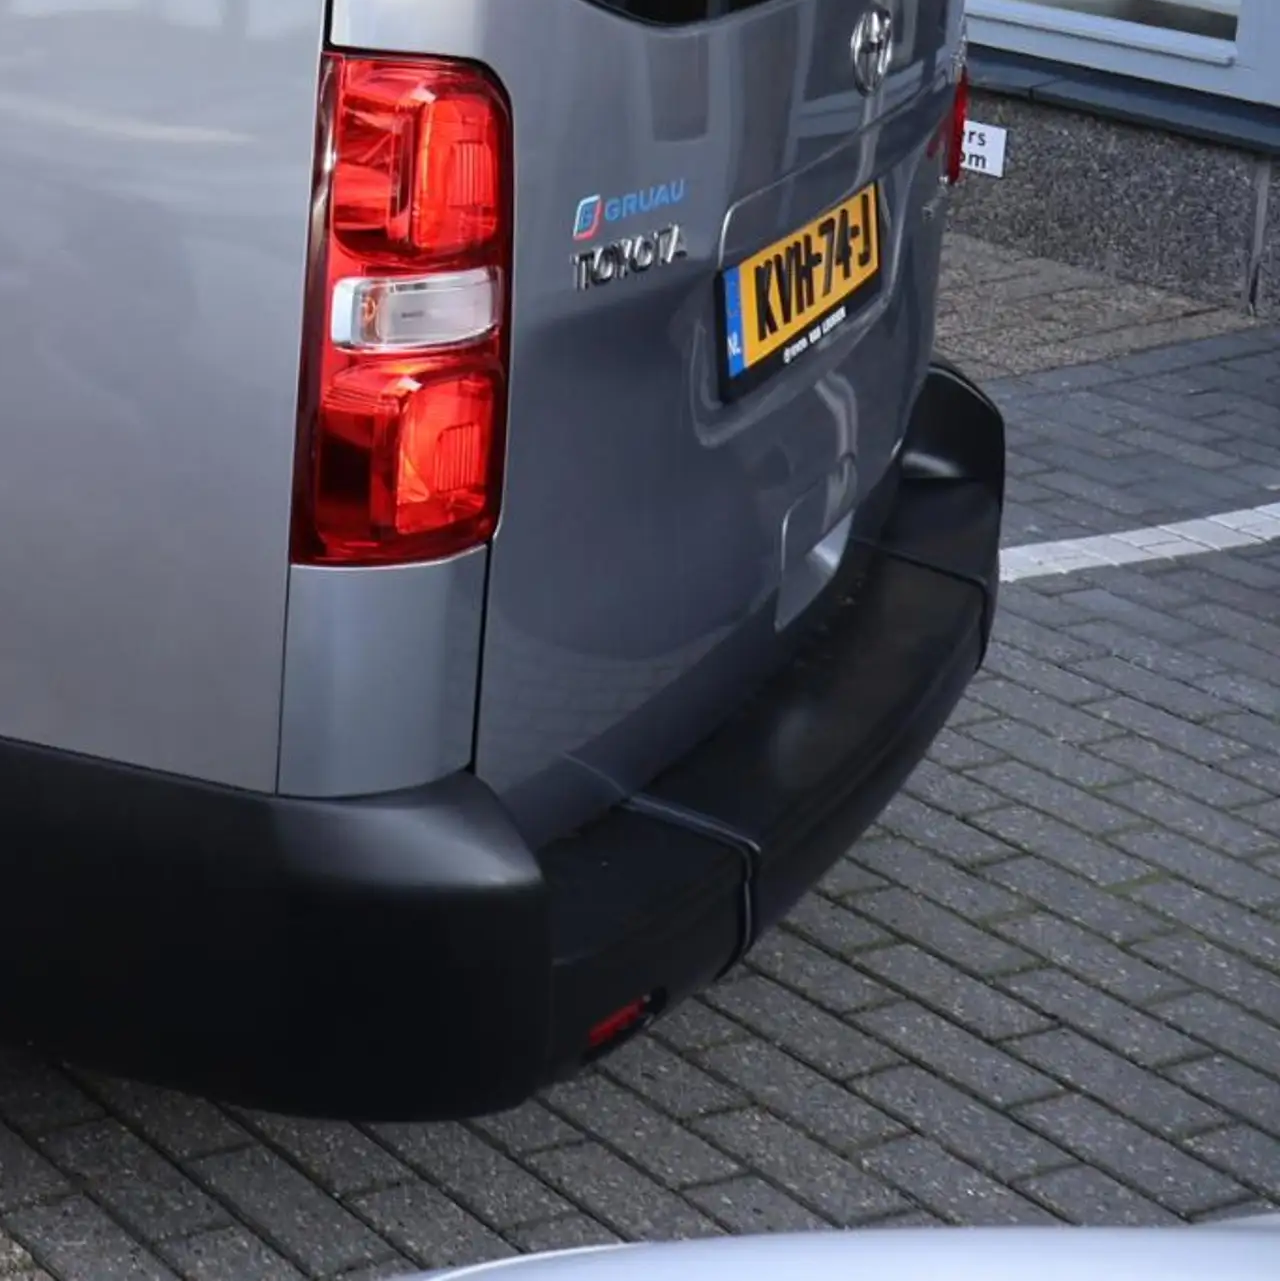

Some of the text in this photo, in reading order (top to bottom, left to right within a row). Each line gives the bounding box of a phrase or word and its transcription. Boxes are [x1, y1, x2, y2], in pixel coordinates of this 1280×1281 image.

[961, 130, 987, 147] rs
[604, 178, 687, 222] GRUAU
[571, 223, 687, 291] TOYOTA
[754, 193, 872, 342] KVH-74-J
